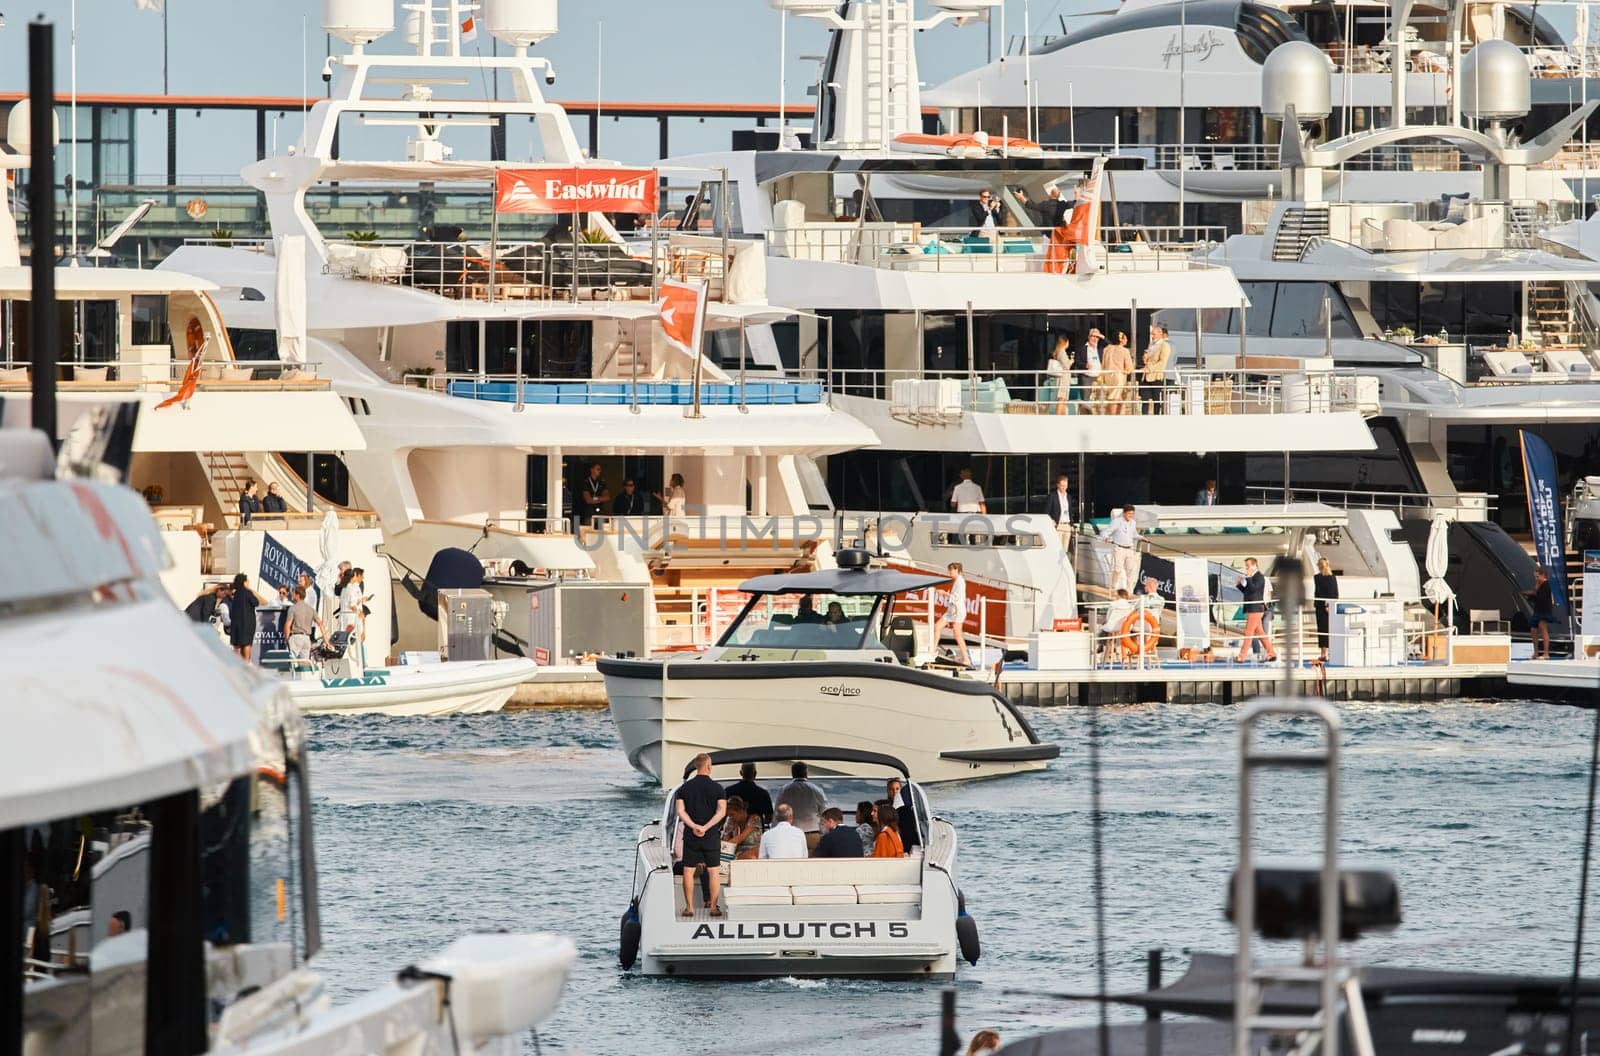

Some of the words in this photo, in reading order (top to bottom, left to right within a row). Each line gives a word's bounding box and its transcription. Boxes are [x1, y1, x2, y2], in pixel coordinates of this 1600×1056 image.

[545, 177, 646, 201] Eastwind
[263, 541, 289, 574] ROYAL
[254, 631, 277, 639] OYAL
[692, 922, 877, 940] ALLDUTCH
[888, 922, 909, 938] 5
